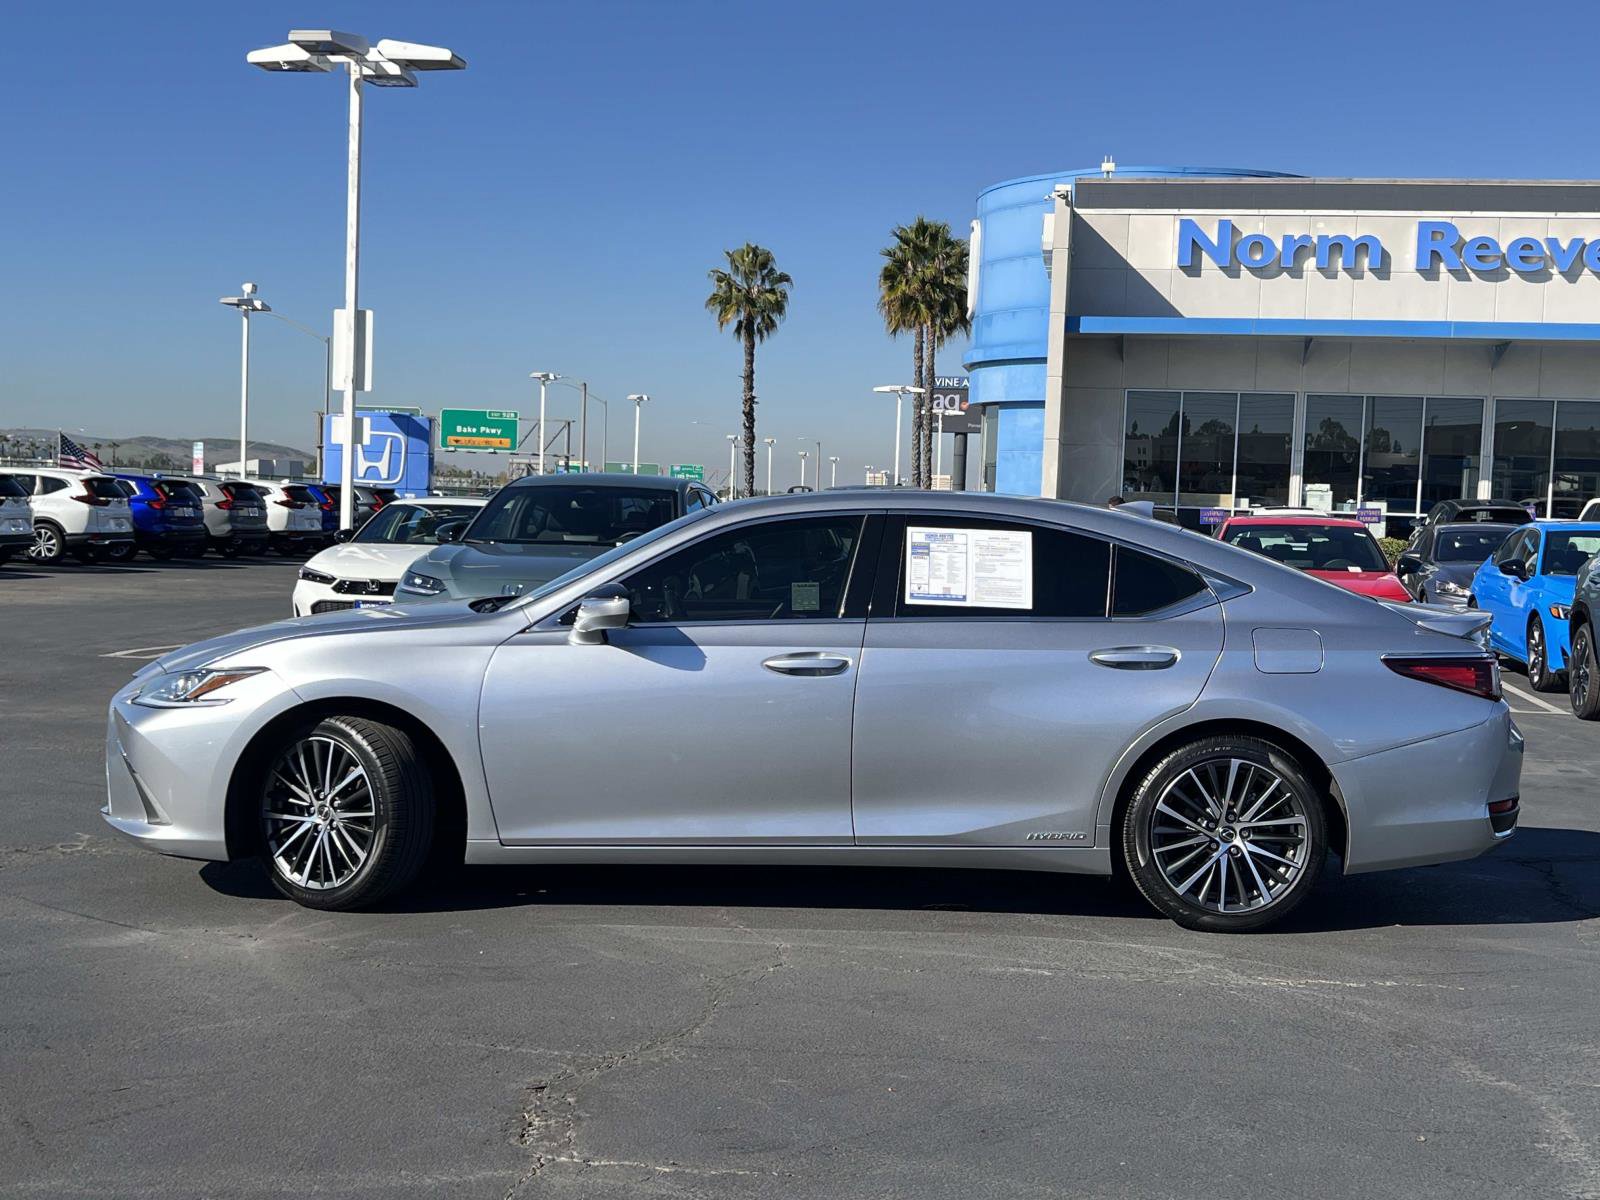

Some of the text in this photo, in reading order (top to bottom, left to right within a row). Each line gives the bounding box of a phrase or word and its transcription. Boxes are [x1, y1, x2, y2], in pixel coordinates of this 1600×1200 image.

[1178, 218, 1382, 269] Norm
[934, 377, 959, 387] VINE
[456, 425, 502, 436] Bake Pkwy
[1026, 831, 1088, 841] HYBRID
